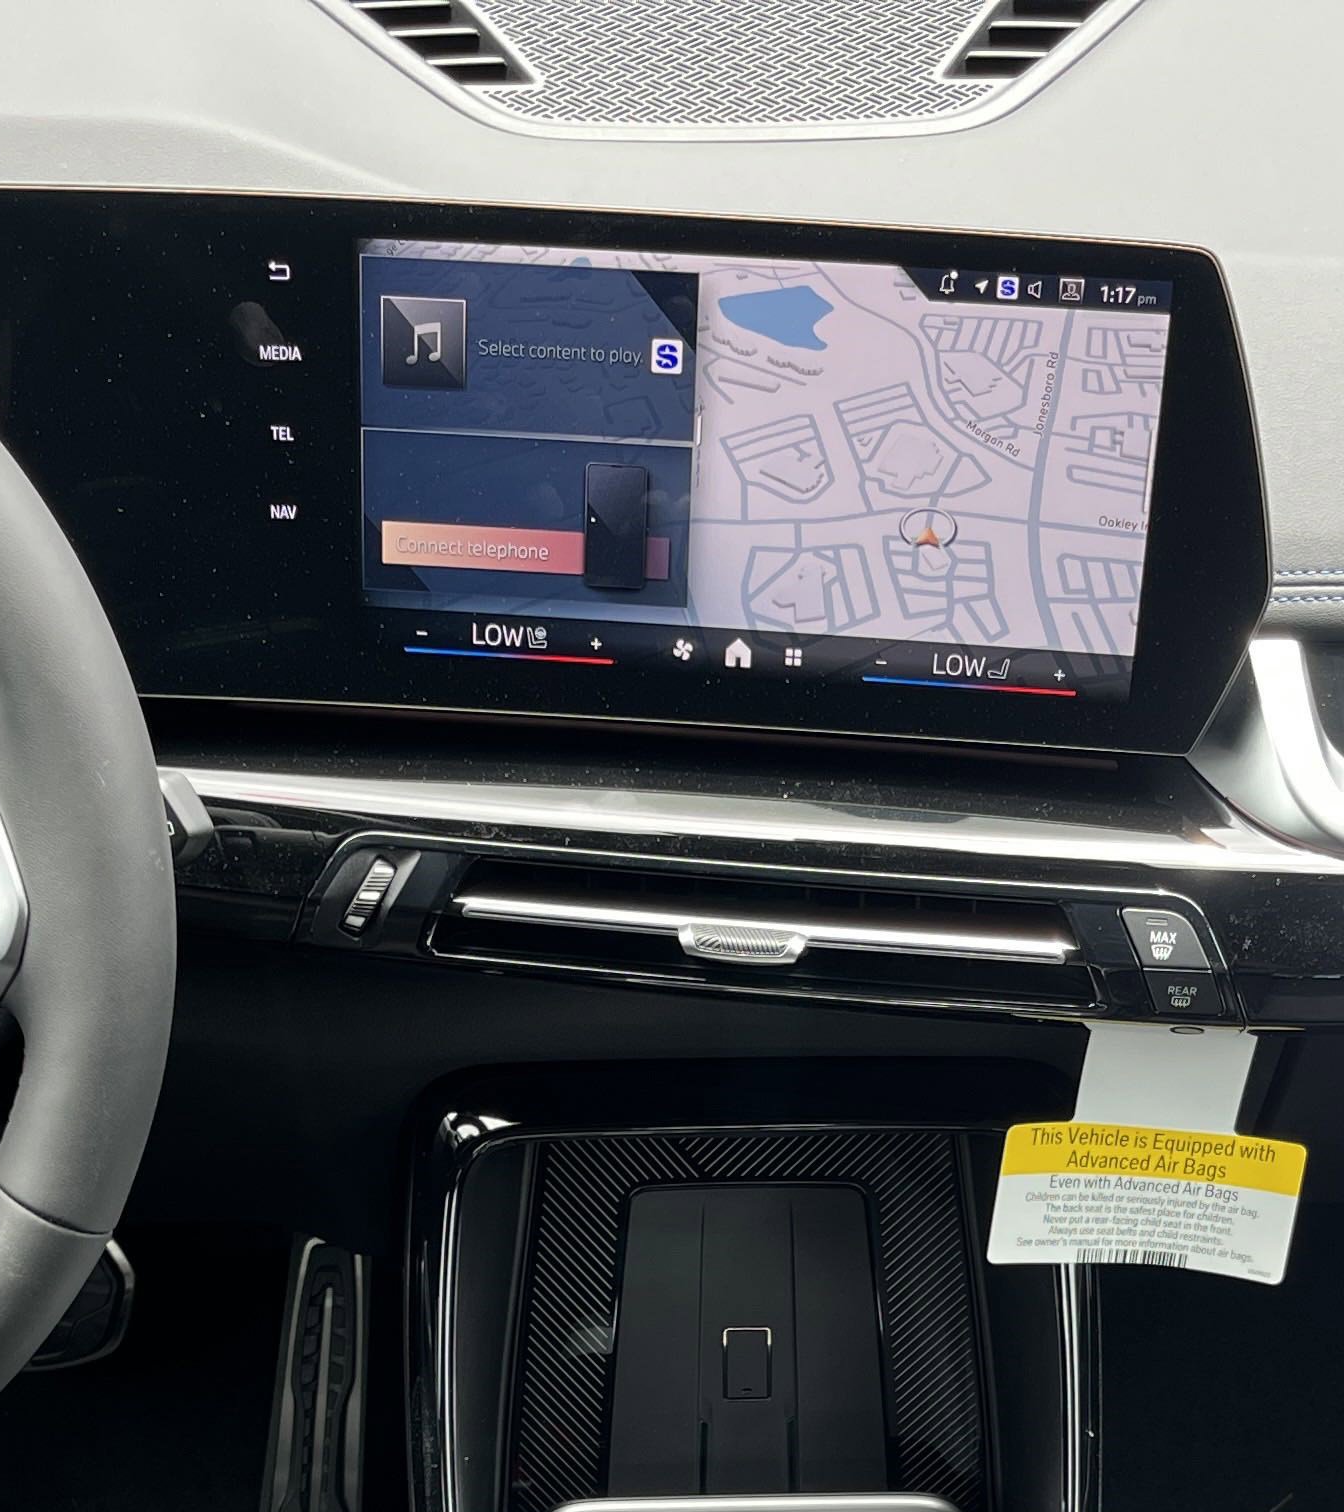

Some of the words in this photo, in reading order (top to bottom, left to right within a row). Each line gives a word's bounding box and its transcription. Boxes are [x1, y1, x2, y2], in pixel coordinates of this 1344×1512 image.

[1100, 285, 1136, 304] 1:17
[1137, 295, 1157, 307] pm
[259, 345, 302, 361] MEDIA
[478, 339, 525, 358] Select
[528, 343, 586, 361] content
[590, 347, 605, 362] to
[609, 348, 644, 368] play.
[1033, 373, 1055, 438] Jonesboro
[1046, 352, 1059, 369] Rd
[270, 425, 294, 441] TEL
[1006, 443, 1021, 457] Rd
[270, 504, 297, 520] NAV
[396, 536, 464, 556] Connect
[467, 540, 550, 561] telephone
[472, 622, 524, 648] LOW
[932, 653, 987, 678] LOW
[1150, 930, 1177, 945] MAX
[1168, 986, 1197, 996] REAR
[1031, 1128, 1063, 1146] This
[1068, 1127, 1130, 1148] Vehicle
[1134, 1131, 1148, 1148] is
[1153, 1132, 1236, 1157] Equipped
[1240, 1143, 1276, 1163] with
[1066, 1150, 1151, 1171] Advanced
[1154, 1154, 1180, 1173] Air
[1183, 1157, 1227, 1182] Bags
[1050, 1175, 1081, 1189] Even
[1083, 1176, 1111, 1190] with
[1113, 1177, 1180, 1194] Advanced
[1182, 1181, 1202, 1197] Air
[1205, 1184, 1239, 1203] Bags
[1025, 1192, 1060, 1202] Children
[1061, 1193, 1077, 1202] can
[1078, 1192, 1090, 1202] be
[1091, 1192, 1114, 1202] killed
[1126, 1195, 1165, 1206] seriously
[1167, 1197, 1197, 1209] injured
[1198, 1200, 1210, 1213] by
[1211, 1203, 1225, 1213] the
[1227, 1204, 1239, 1214] air
[1046, 1203, 1058, 1213] The
[1063, 1203, 1082, 1213] back
[1085, 1204, 1103, 1213] seat
[1105, 1204, 1112, 1213] is
[1113, 1204, 1127, 1214] the
[1129, 1206, 1155, 1216] safest
[1157, 1207, 1181, 1218] place
[1183, 1208, 1195, 1219] for
[1197, 1211, 1234, 1225] children.
[1043, 1214, 1067, 1224] Never
[1069, 1215, 1083, 1225] put
[1091, 1215, 1138, 1227] rear-facing
[1140, 1217, 1161, 1227] child
[1163, 1219, 1182, 1229] seat
[1184, 1221, 1192, 1230] in
[1194, 1222, 1208, 1232] the
[1209, 1223, 1232, 1236] front.
[1048, 1226, 1078, 1237] Always
[1079, 1227, 1095, 1235] use
[1096, 1226, 1115, 1236] seat
[1116, 1226, 1137, 1236] belts
[1139, 1228, 1156, 1238] and
[1157, 1229, 1178, 1239] child
[1180, 1232, 1224, 1245] restraints.
[1016, 1237, 1034, 1247] See
[1069, 1237, 1101, 1247] manual
[1102, 1237, 1113, 1247] for
[1115, 1238, 1137, 1247] more
[1139, 1239, 1189, 1251] information
[1190, 1245, 1217, 1256] about
[1217, 1248, 1229, 1258] air
[1231, 1251, 1254, 1263] bags.
